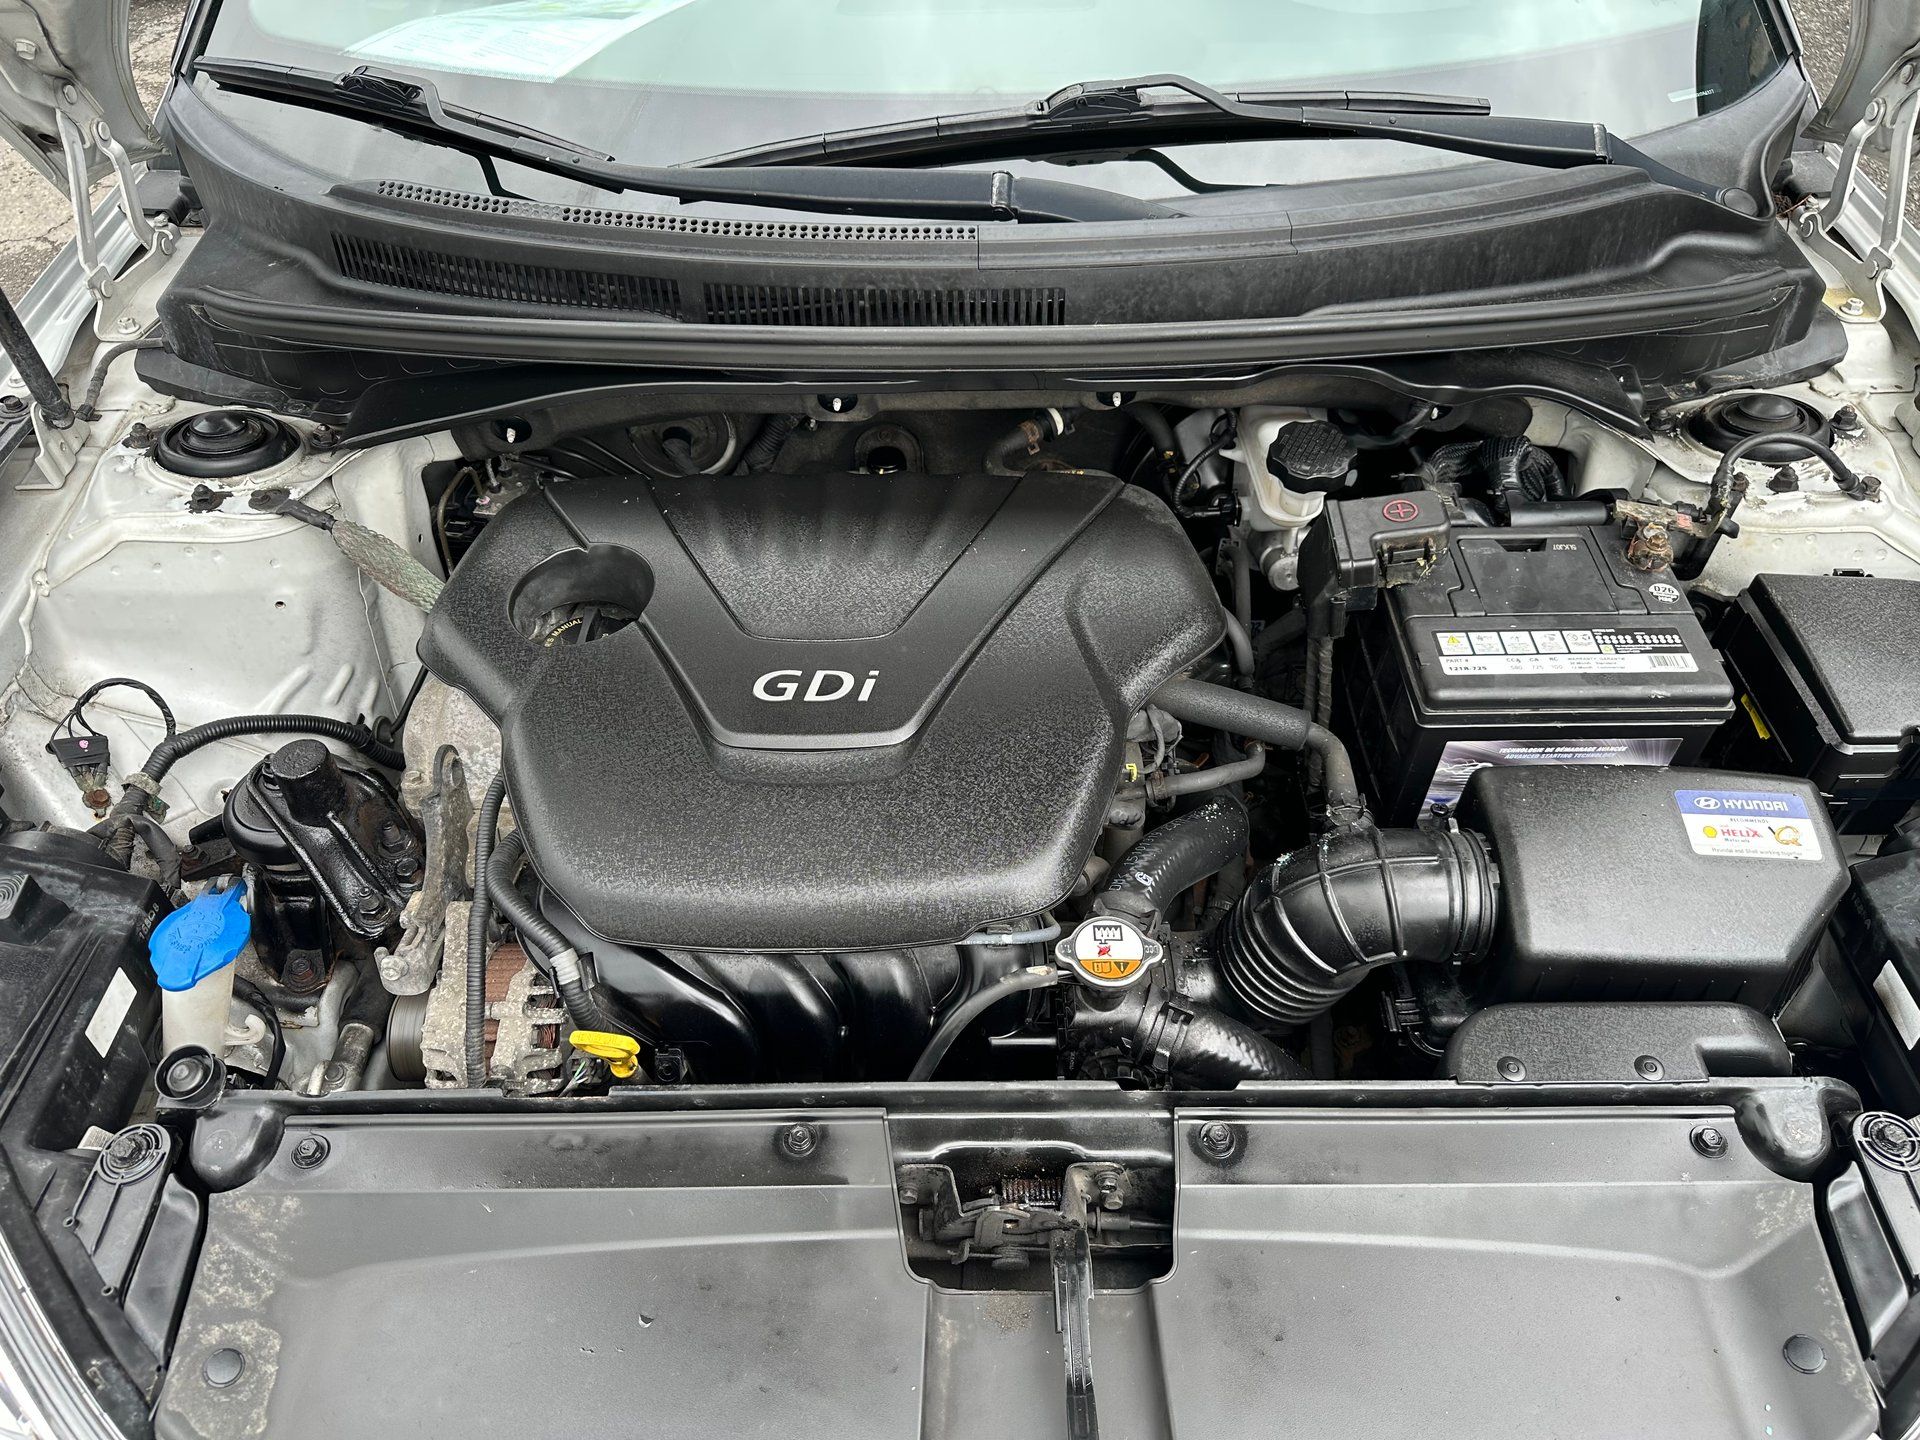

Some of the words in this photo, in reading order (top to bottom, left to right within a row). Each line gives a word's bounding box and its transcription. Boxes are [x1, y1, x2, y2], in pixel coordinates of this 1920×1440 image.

[551, 618, 583, 638] MANUAL
[752, 669, 880, 702] GDi
[1723, 799, 1789, 812] HYUNDAI
[1721, 828, 1761, 839] HELIX
